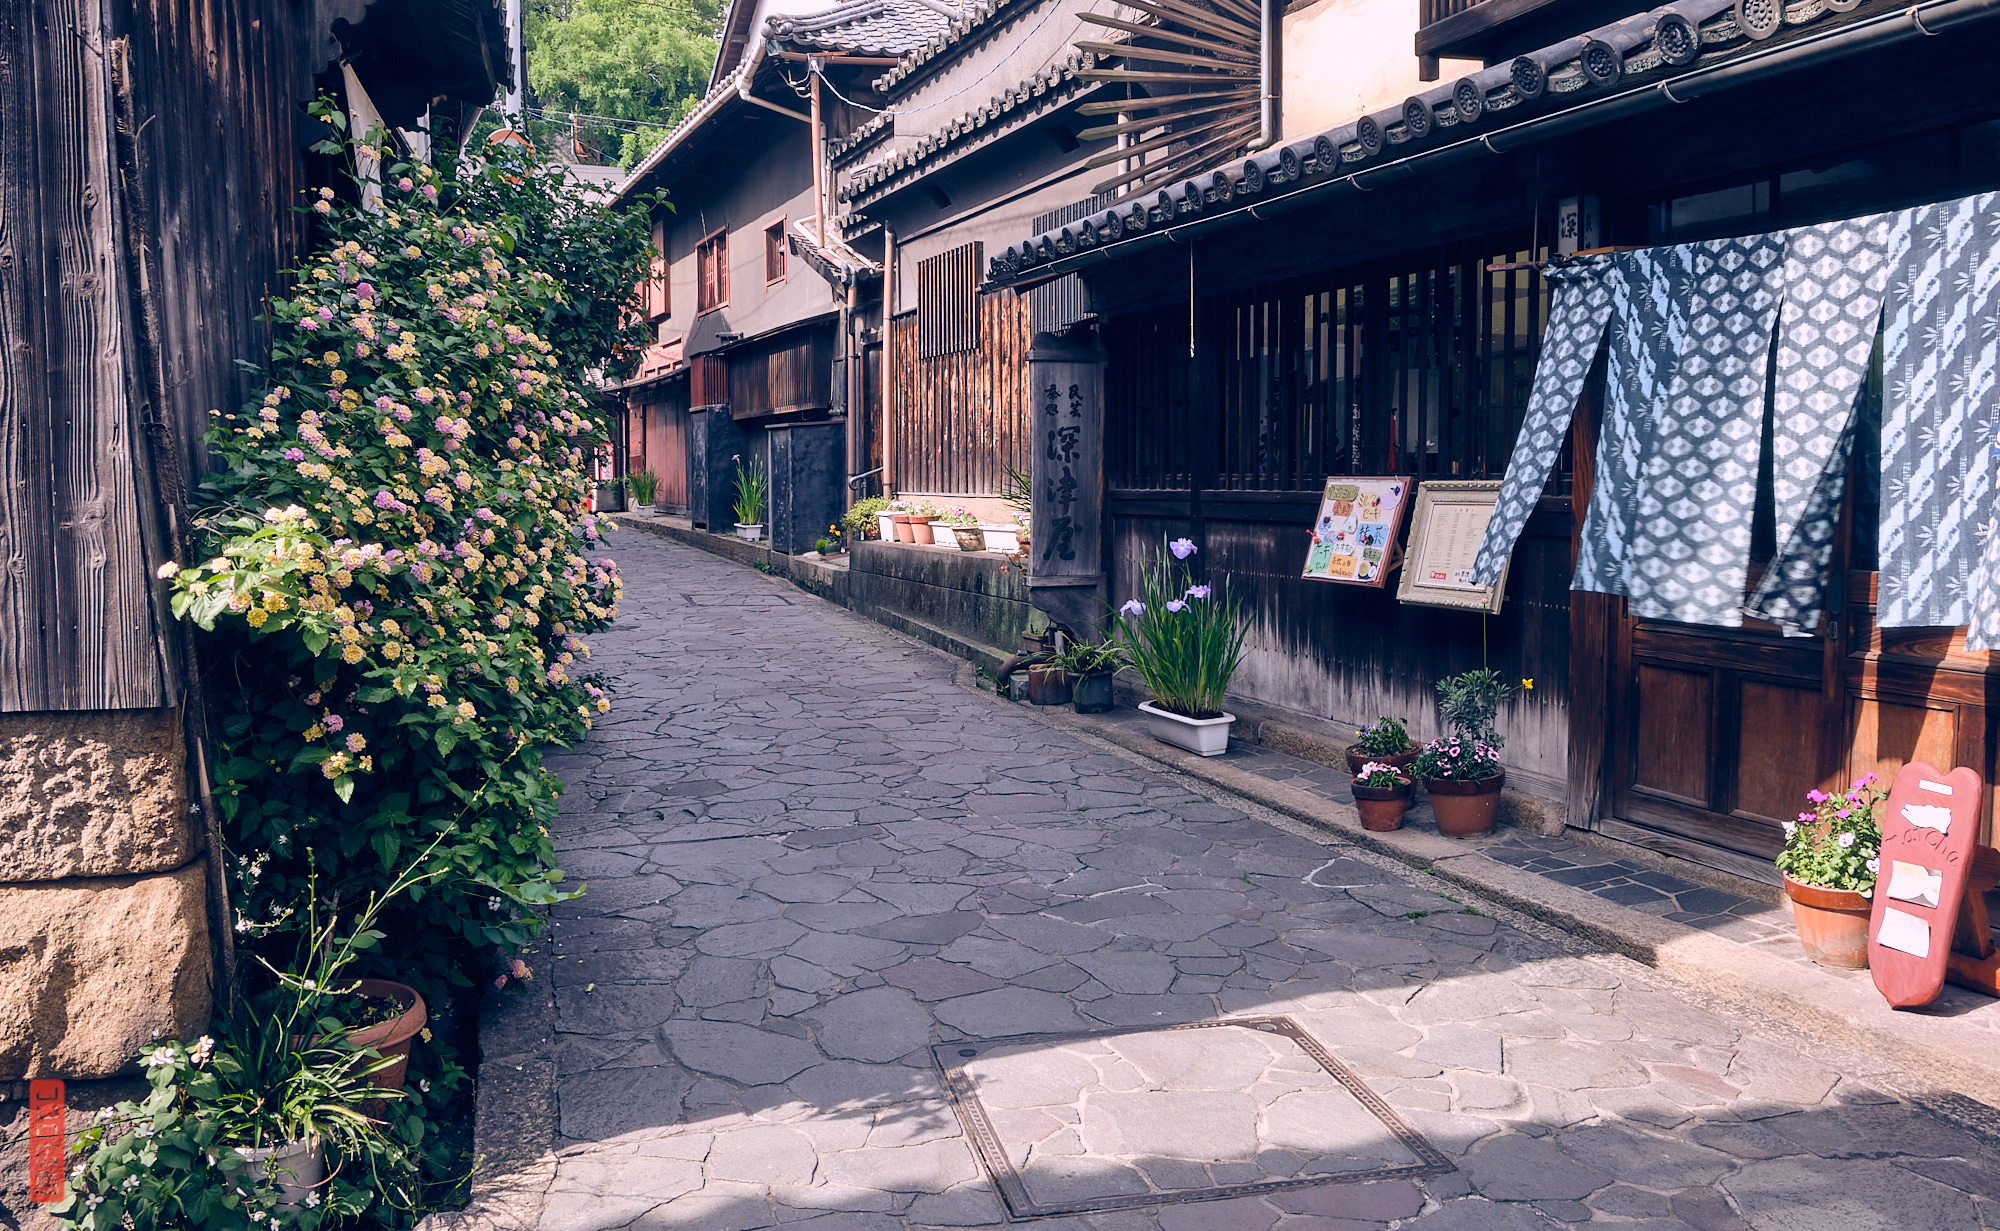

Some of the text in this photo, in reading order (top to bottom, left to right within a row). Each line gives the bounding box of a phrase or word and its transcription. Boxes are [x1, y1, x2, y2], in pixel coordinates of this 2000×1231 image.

[1068, 384, 1084, 417] 民芸
[1043, 425, 1082, 561] 深津屋
